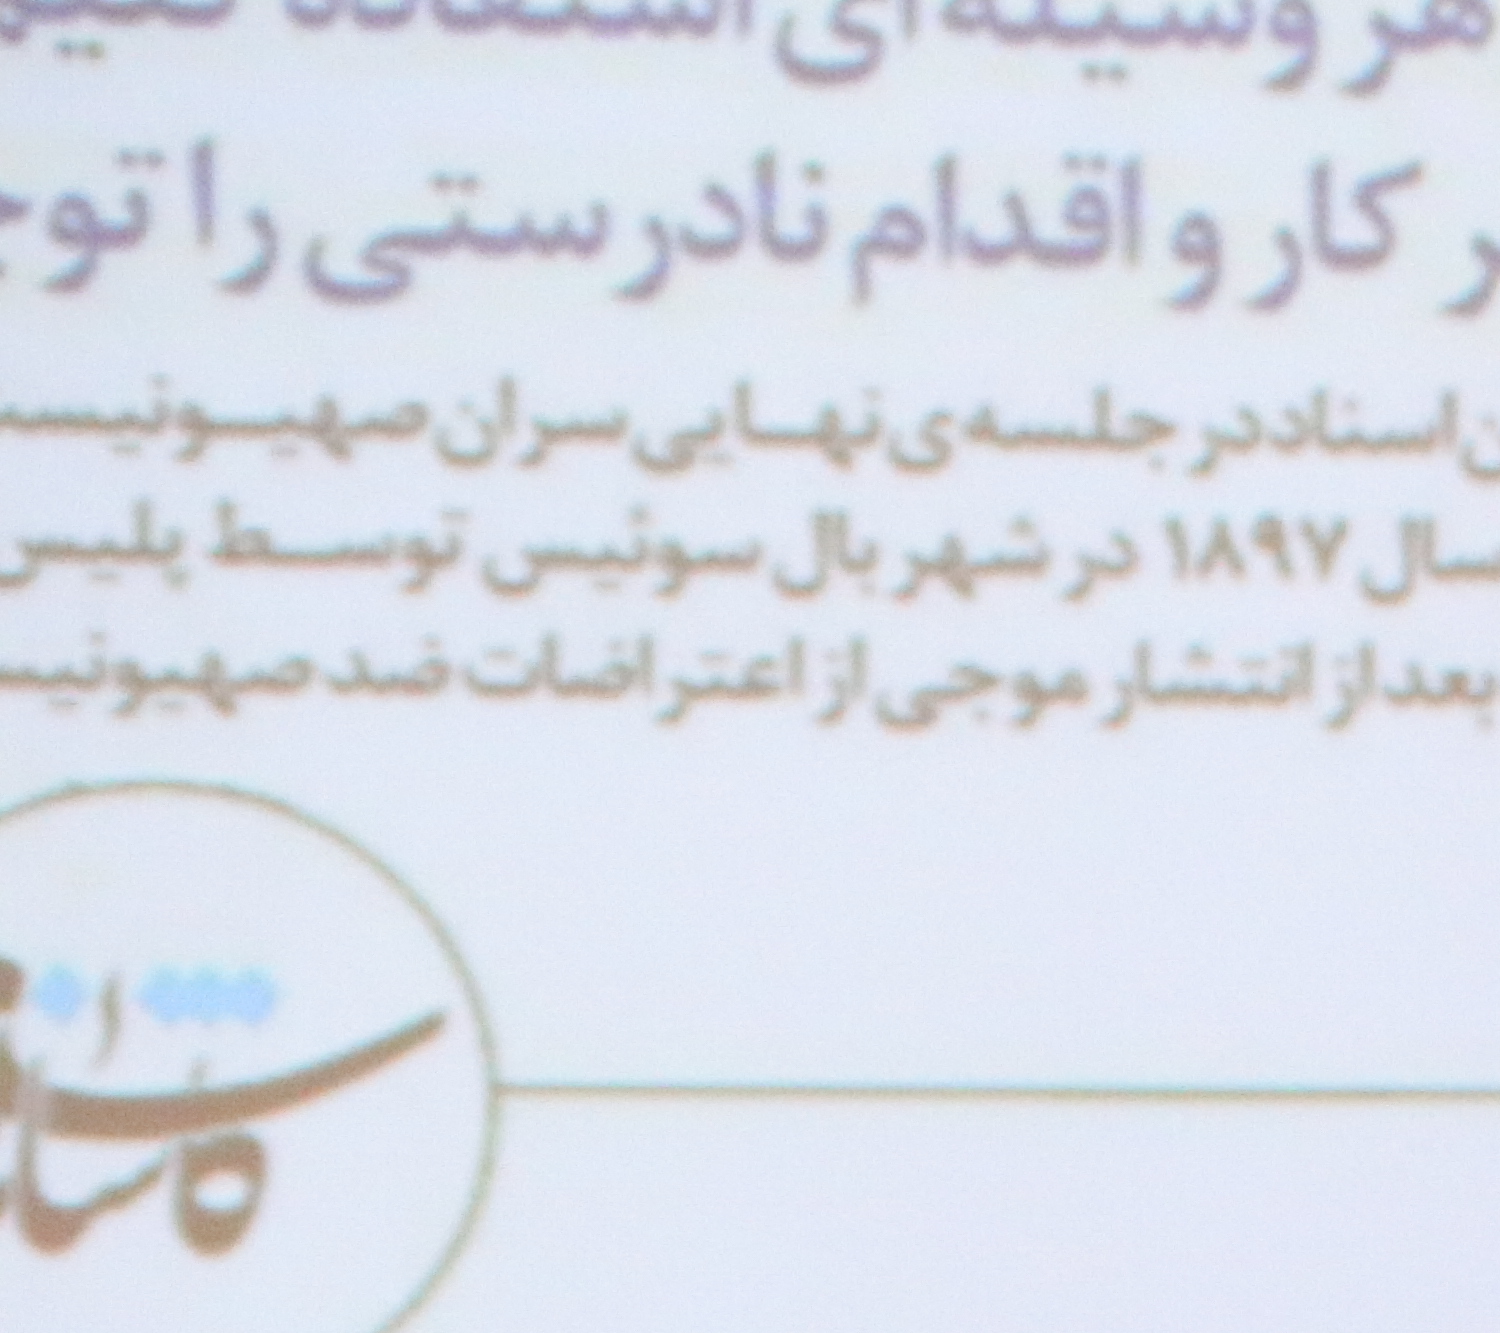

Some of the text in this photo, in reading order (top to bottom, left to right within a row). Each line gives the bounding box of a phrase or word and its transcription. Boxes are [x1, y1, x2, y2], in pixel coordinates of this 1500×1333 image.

[1340, 0, 1496, 99] هر
[0, 146, 166, 295] تو
[188, 133, 280, 296] را
[300, 146, 830, 307] نادرستی
[847, 150, 1143, 303] اقدام
[1167, 208, 1224, 313] و
[1246, 157, 1424, 315] کار
[0, 376, 430, 463] صهیونیس
[434, 374, 629, 471] سران
[630, 378, 883, 477] نهایی
[1189, 404, 1265, 478] در
[1266, 386, 1459, 457] اسناد
[208, 496, 470, 595] توسط
[772, 506, 879, 602] بال
[893, 512, 1051, 603] شهر
[1062, 529, 1140, 604] در
[1163, 510, 1349, 579] ۱۸۹۷
[0, 630, 316, 719] صهیونیس
[326, 632, 453, 698] ضد
[463, 633, 805, 726] اعتراضات
[819, 635, 867, 725] از
[874, 660, 1090, 734] موجی
[1102, 639, 1315, 730] انتشار
[1326, 639, 1376, 731] از
[1381, 660, 1500, 730] بعد
